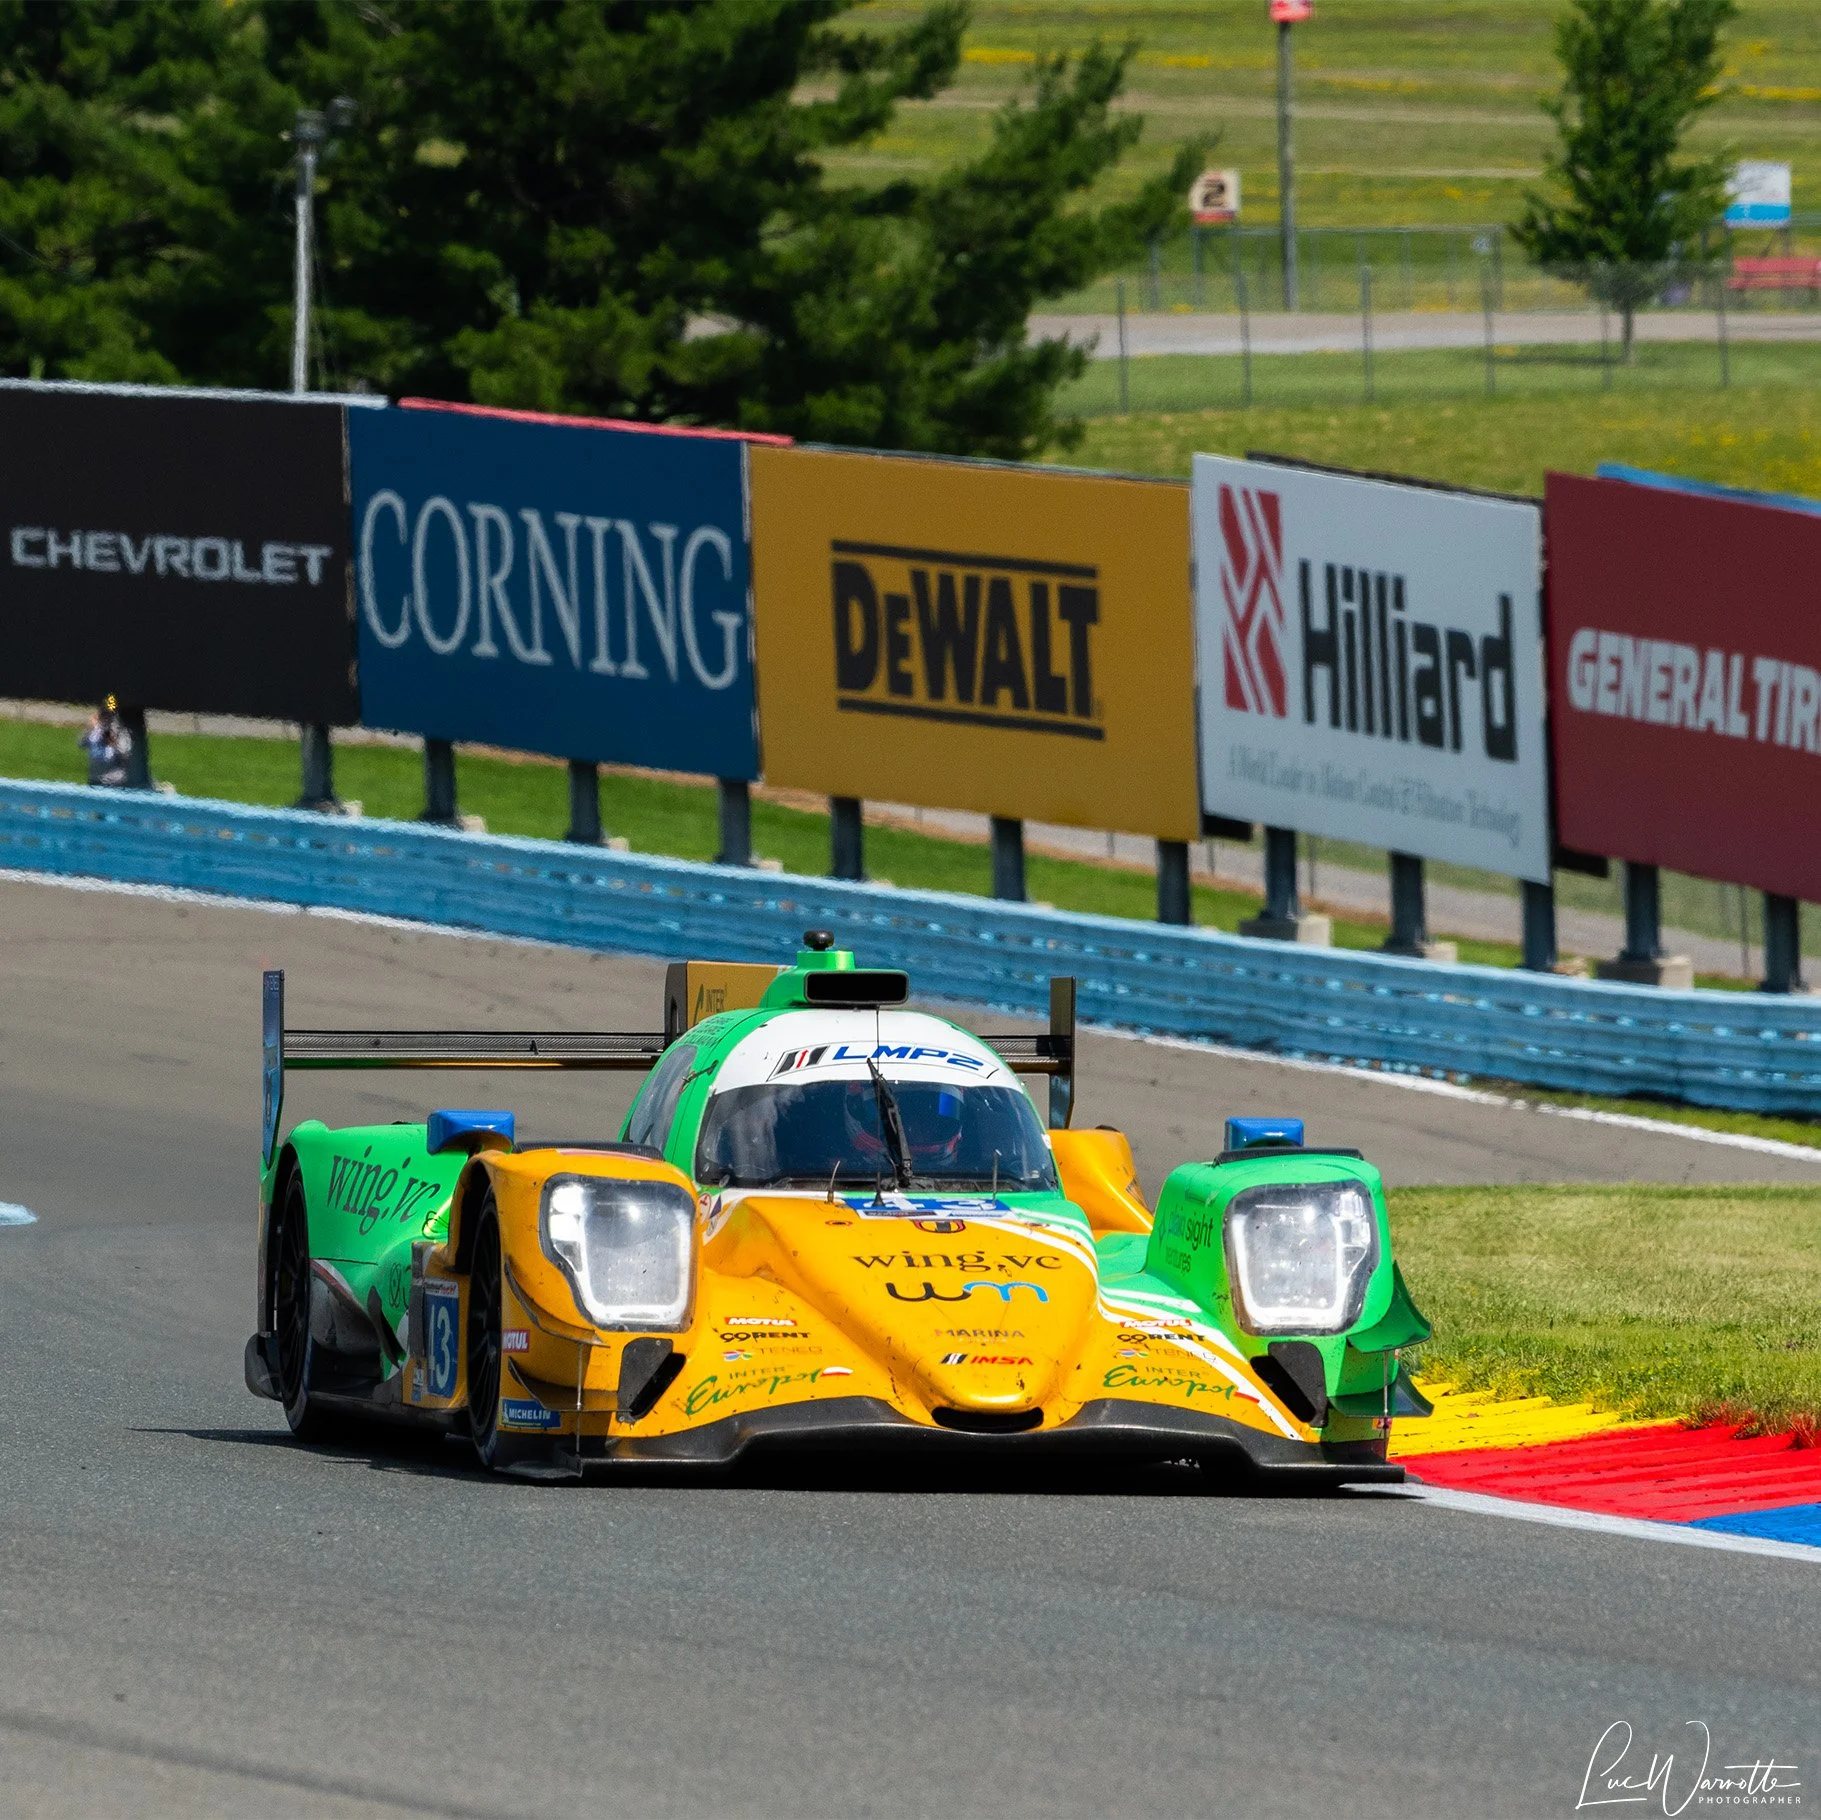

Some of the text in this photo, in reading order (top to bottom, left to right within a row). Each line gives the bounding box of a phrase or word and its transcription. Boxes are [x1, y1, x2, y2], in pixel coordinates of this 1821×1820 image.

[1202, 179, 1226, 207] 2
[10, 526, 333, 586] CHEVROLET
[360, 490, 743, 689] CORNING
[1299, 558, 1518, 763] Hilliard
[1567, 627, 1821, 757] GENERAL TIR
[832, 1045, 984, 1071] LMP2
[326, 1146, 441, 1236] wing.vc
[1186, 1211, 1214, 1251] sight
[852, 1251, 1063, 1272] wing.vc
[728, 1317, 795, 1327] MOTUL
[935, 1329, 1025, 1338] MARINA
[1124, 1320, 1191, 1328] MOTUL
[503, 1332, 528, 1349] MOTUL
[970, 1355, 1034, 1366] IMSA
[685, 1368, 823, 1415] Europol
[1103, 1365, 1236, 1400] Europol
[508, 1408, 551, 1420] MICHELIN
